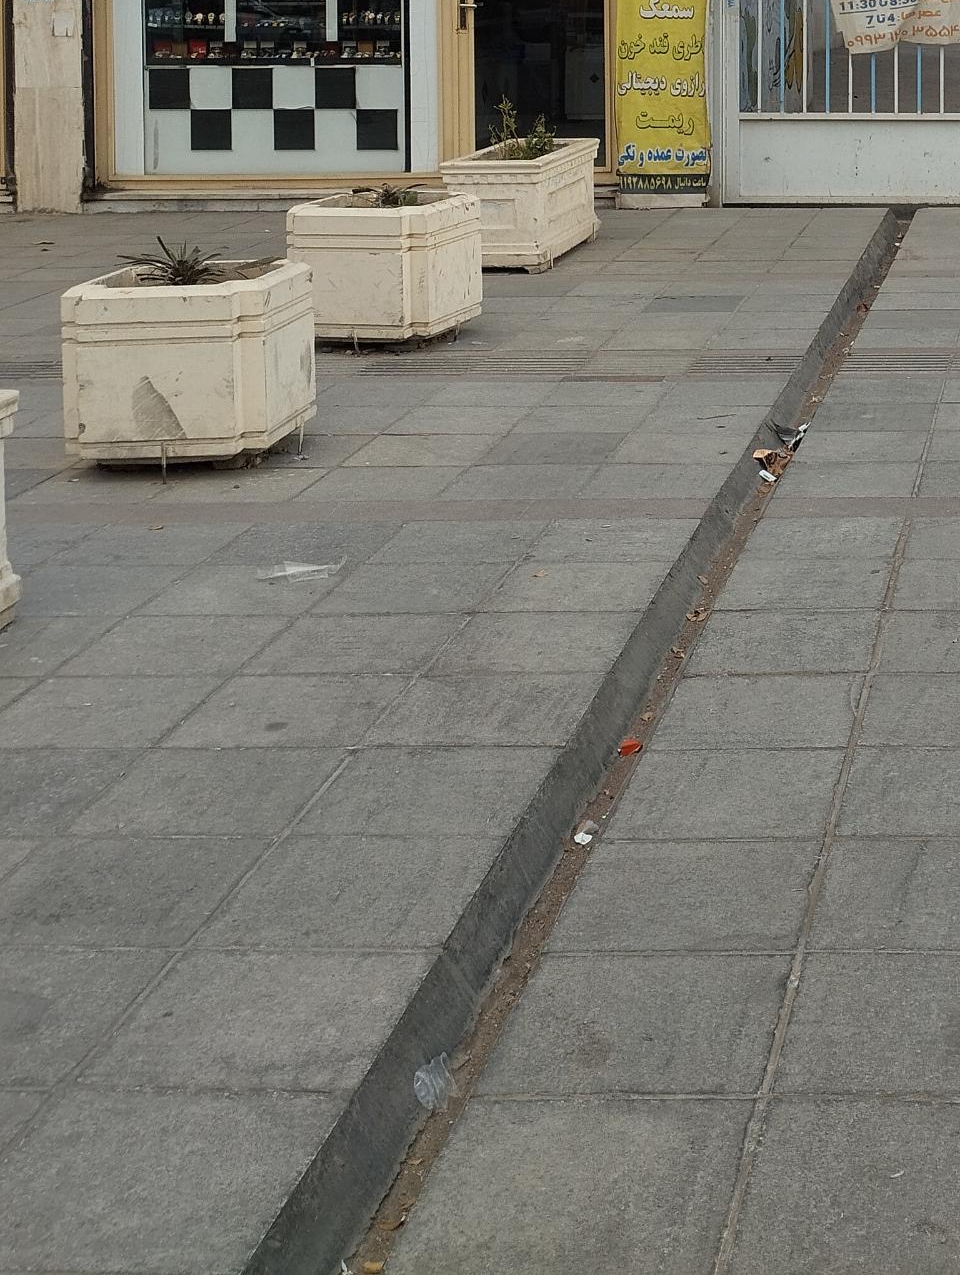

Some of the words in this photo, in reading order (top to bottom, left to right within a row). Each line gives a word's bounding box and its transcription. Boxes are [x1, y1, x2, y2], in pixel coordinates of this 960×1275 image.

[865, 15, 875, 25] 7
[876, 14, 886, 24] تا
[887, 13, 896, 23] 4
[617, 33, 646, 61] خون
[648, 32, 670, 55] قند
[672, 33, 705, 61] طری
[616, 70, 668, 96] دیجیتالی
[670, 70, 706, 98] رازوی
[635, 111, 695, 136] ریمت
[617, 143, 636, 166] تکی
[638, 151, 645, 167] و
[647, 148, 672, 162] عمده
